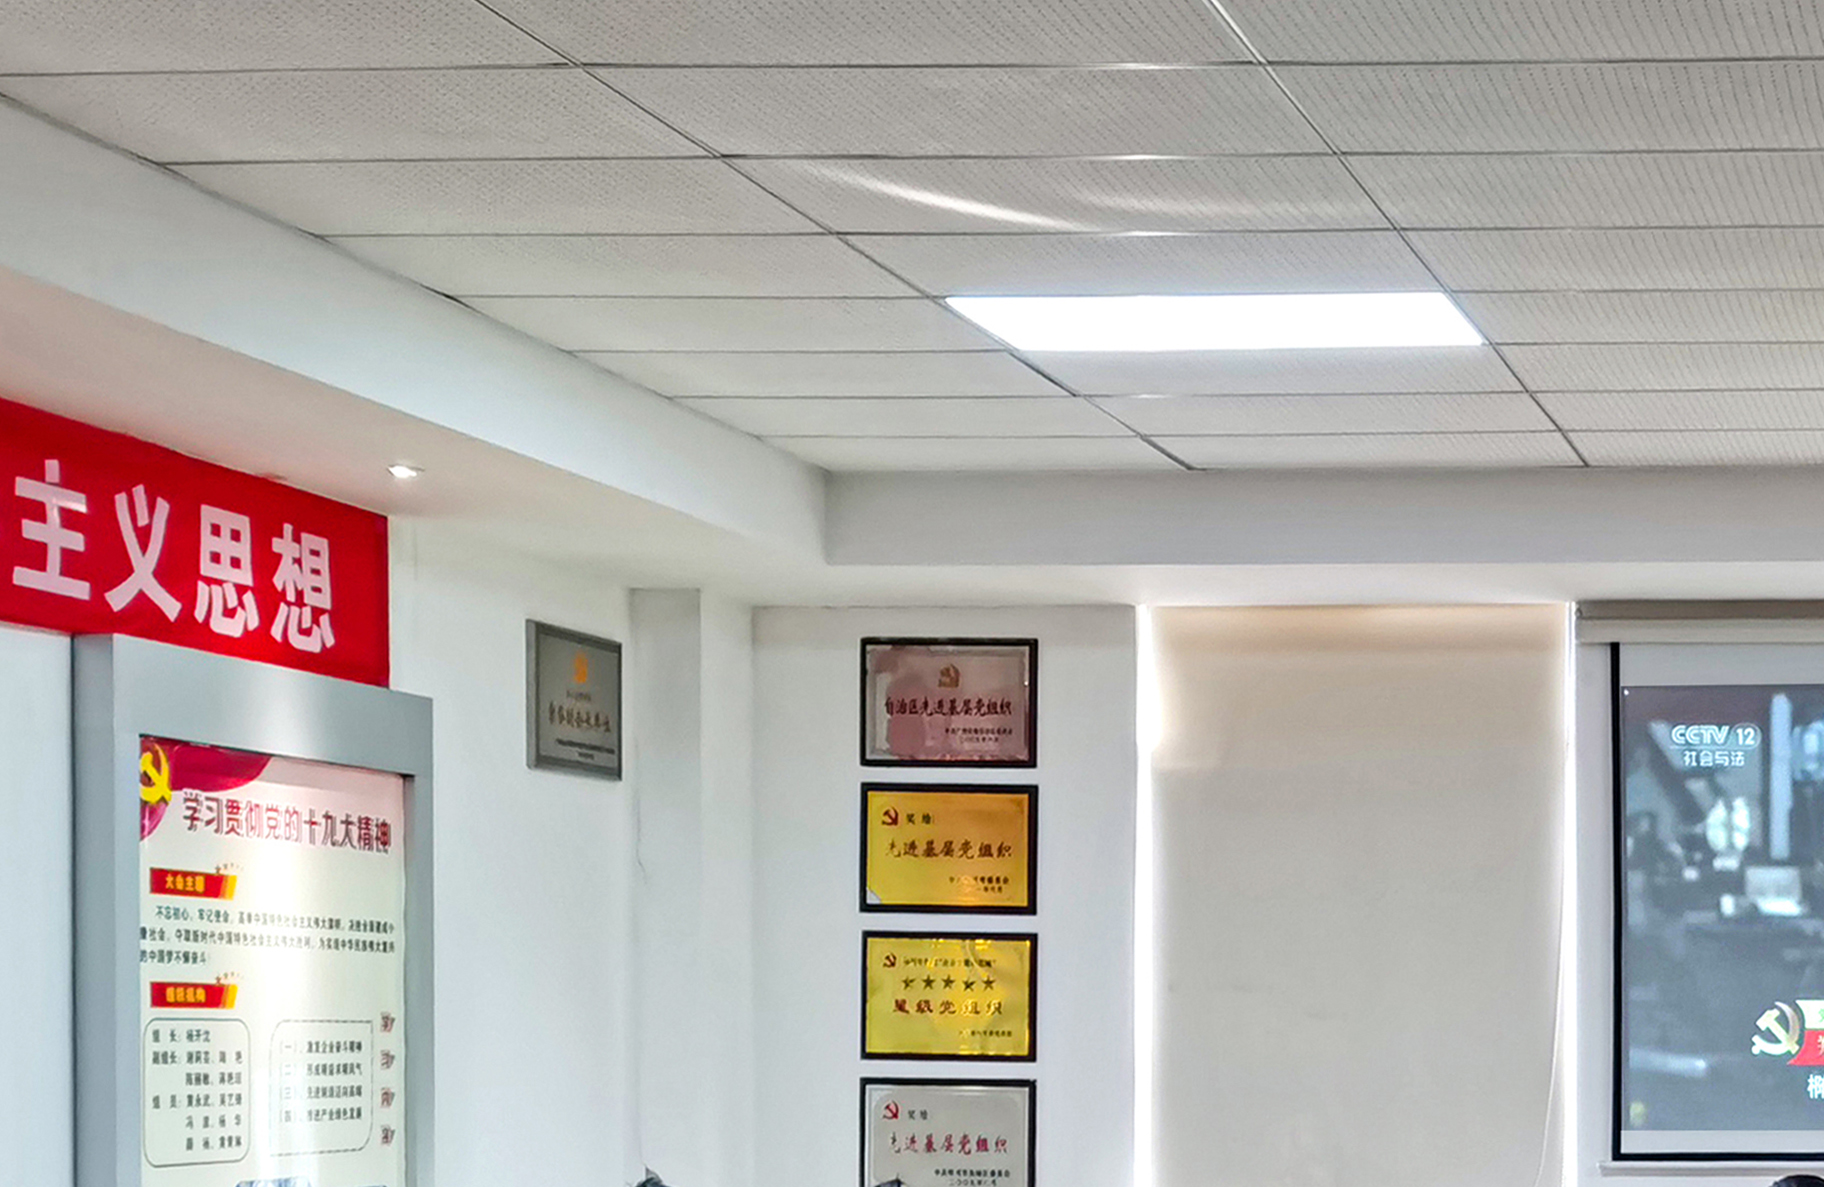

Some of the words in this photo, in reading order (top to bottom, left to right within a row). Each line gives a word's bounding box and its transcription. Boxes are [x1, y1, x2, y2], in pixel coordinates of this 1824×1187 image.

[12, 458, 336, 655] 主义思想
[1671, 724, 1730, 746] CCTV
[1735, 727, 1755, 746] 12
[1683, 750, 1745, 767] 社会与法
[181, 788, 392, 854] 学习贯彻党的十九大精神
[885, 838, 1013, 860] 先进基层党组织
[888, 1131, 1009, 1155] 先进基层党组织
